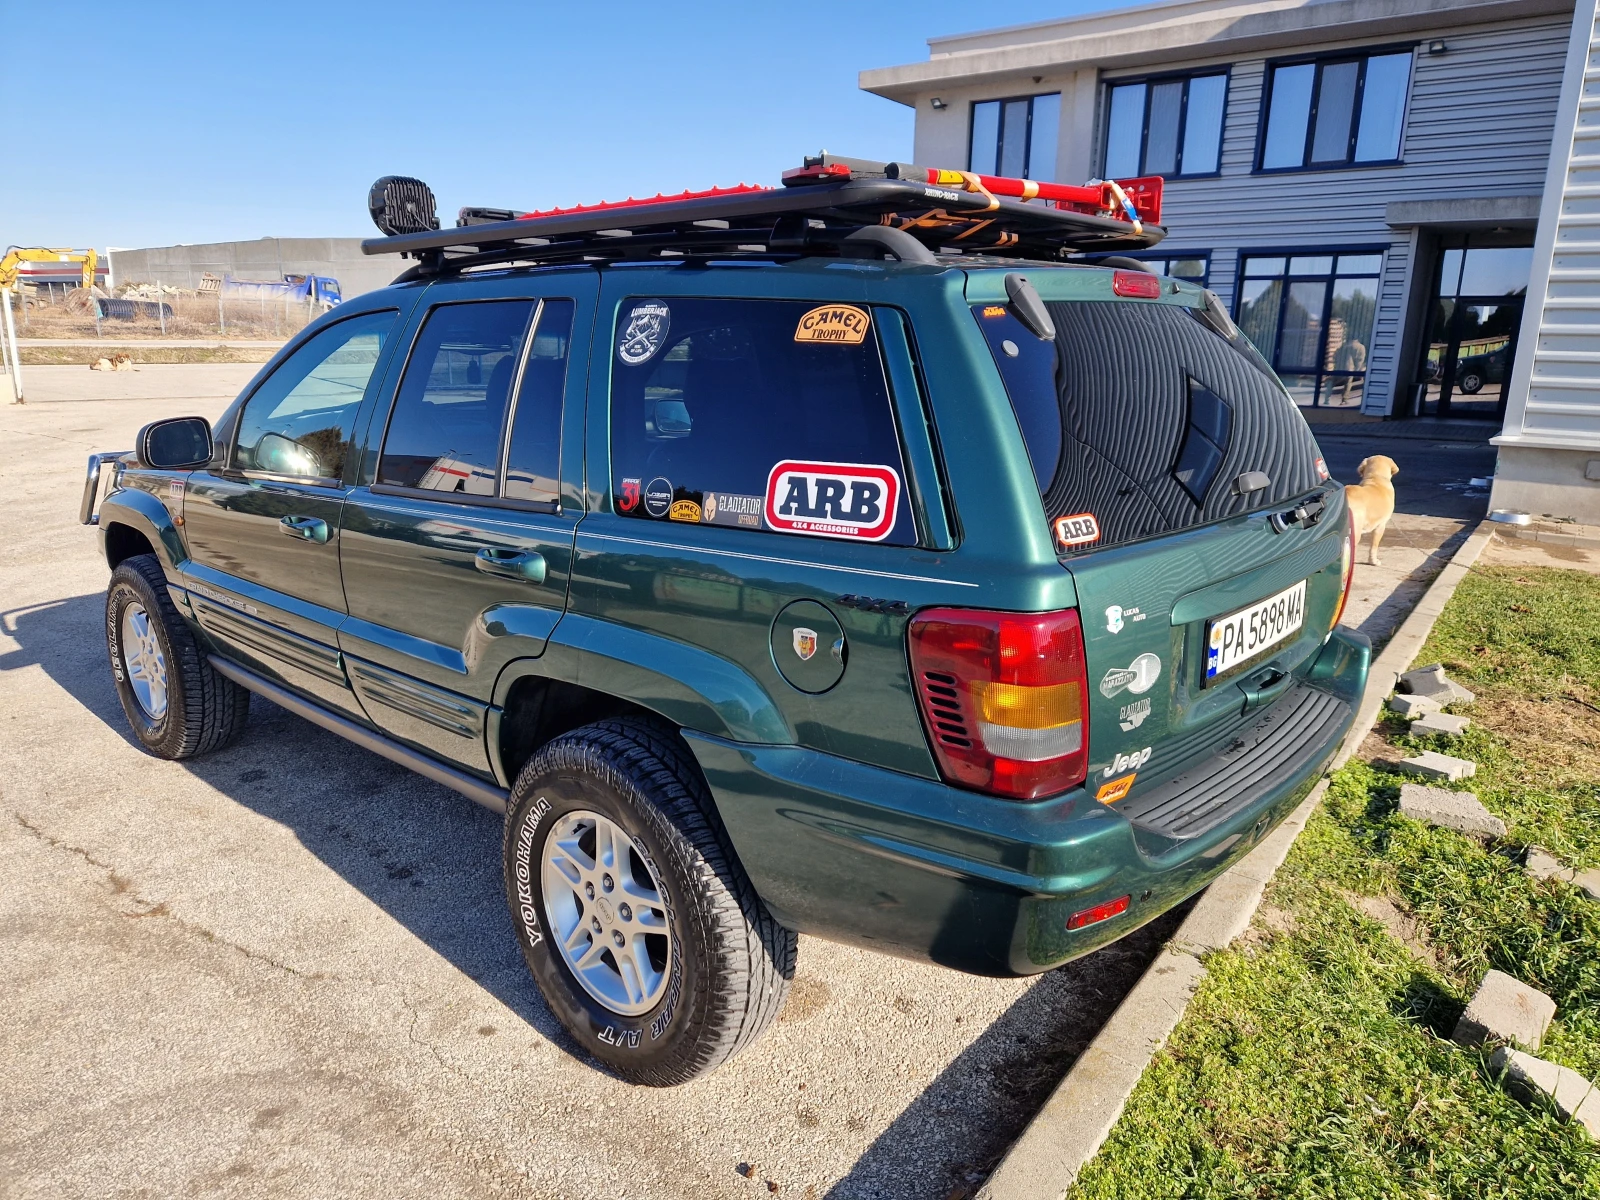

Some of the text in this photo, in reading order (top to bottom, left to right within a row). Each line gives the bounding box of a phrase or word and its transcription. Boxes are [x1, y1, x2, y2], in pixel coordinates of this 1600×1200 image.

[924, 187, 959, 201] RHINO-RACK
[630, 307, 668, 317] LUMBERJACK
[803, 311, 863, 335] CAMEL
[811, 328, 849, 340] TROPHY
[718, 495, 761, 515] GLADIATOR
[779, 476, 881, 523] ARB
[672, 503, 699, 517] CAMEL
[809, 523, 859, 535] ACCESSORIES
[1062, 518, 1096, 540] ARB
[1123, 606, 1140, 617] LUCAS
[1132, 613, 1147, 622] AUTO
[1221, 587, 1302, 665] PA 5898 MA
[1207, 655, 1218, 670] BG
[1103, 746, 1152, 778] Jeep
[515, 797, 552, 947] YOKOHAMA
[597, 836, 684, 1049] GEOLANDAR A/T
